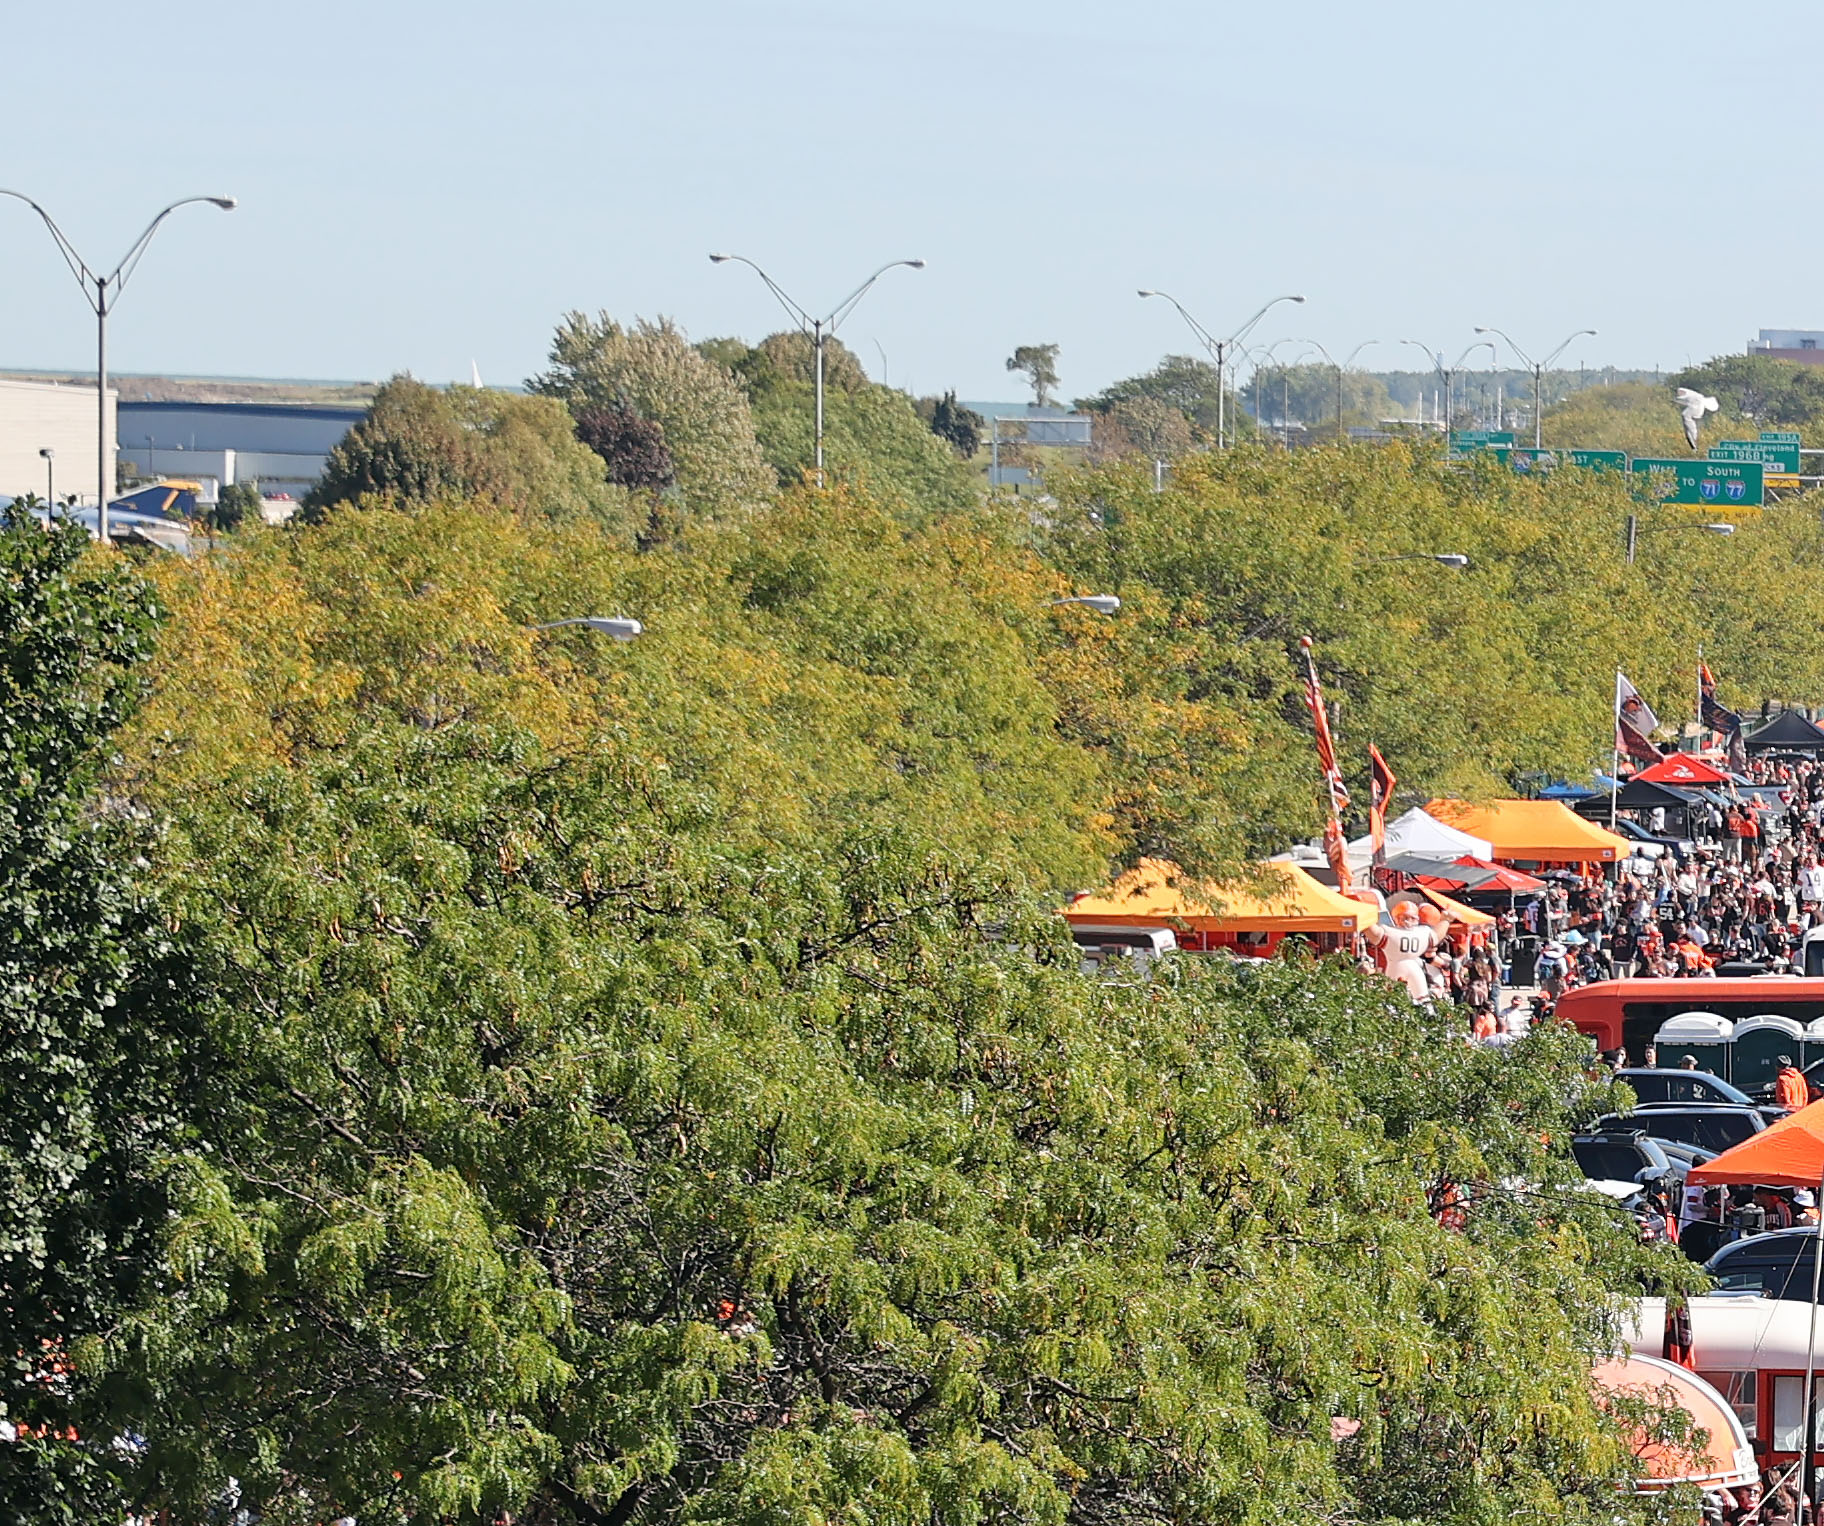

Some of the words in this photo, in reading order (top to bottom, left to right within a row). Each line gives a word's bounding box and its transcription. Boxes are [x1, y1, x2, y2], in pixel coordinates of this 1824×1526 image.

[1711, 451, 1728, 459] EXIT
[1733, 450, 1761, 460] 196B
[1707, 467, 1740, 477] SOUTH
[1682, 478, 1695, 487] TO
[1399, 936, 1420, 953] 00
